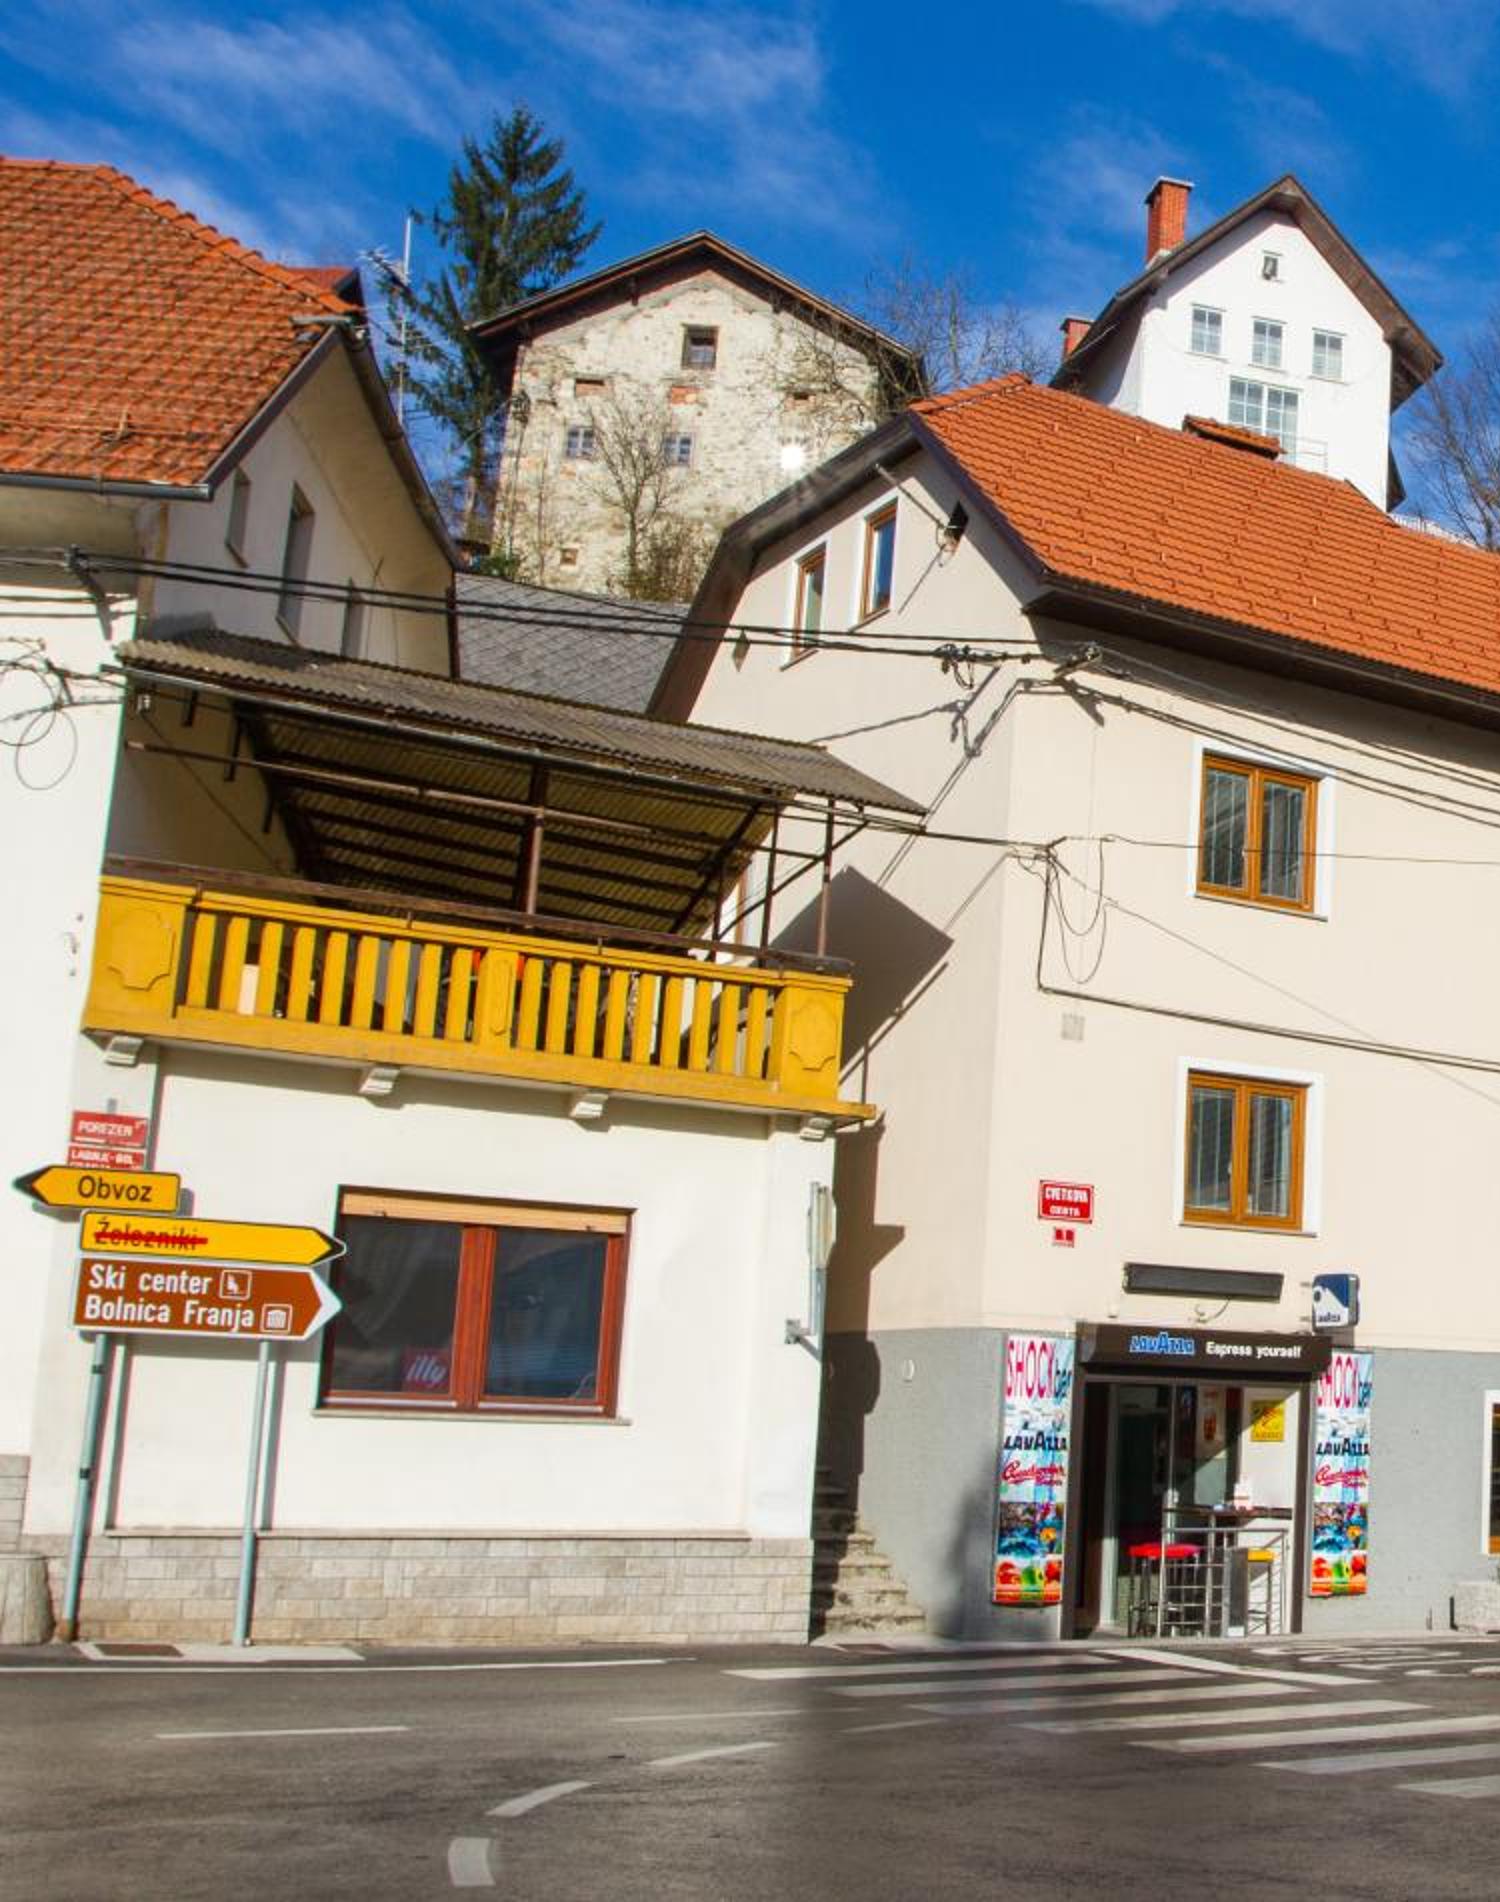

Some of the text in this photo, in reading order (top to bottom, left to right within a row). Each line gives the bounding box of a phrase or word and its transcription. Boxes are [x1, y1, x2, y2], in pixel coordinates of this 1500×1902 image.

[78, 1175, 152, 1202] Obvoz
[89, 1264, 213, 1295] Ski center
[84, 1295, 255, 1332] Bolnica Franja
[1256, 1344, 1302, 1360] yourself
[406, 1355, 448, 1388] illy
[1004, 1431, 1067, 1450] LAVAZZA
[1316, 1438, 1370, 1456] LAVAZZA
